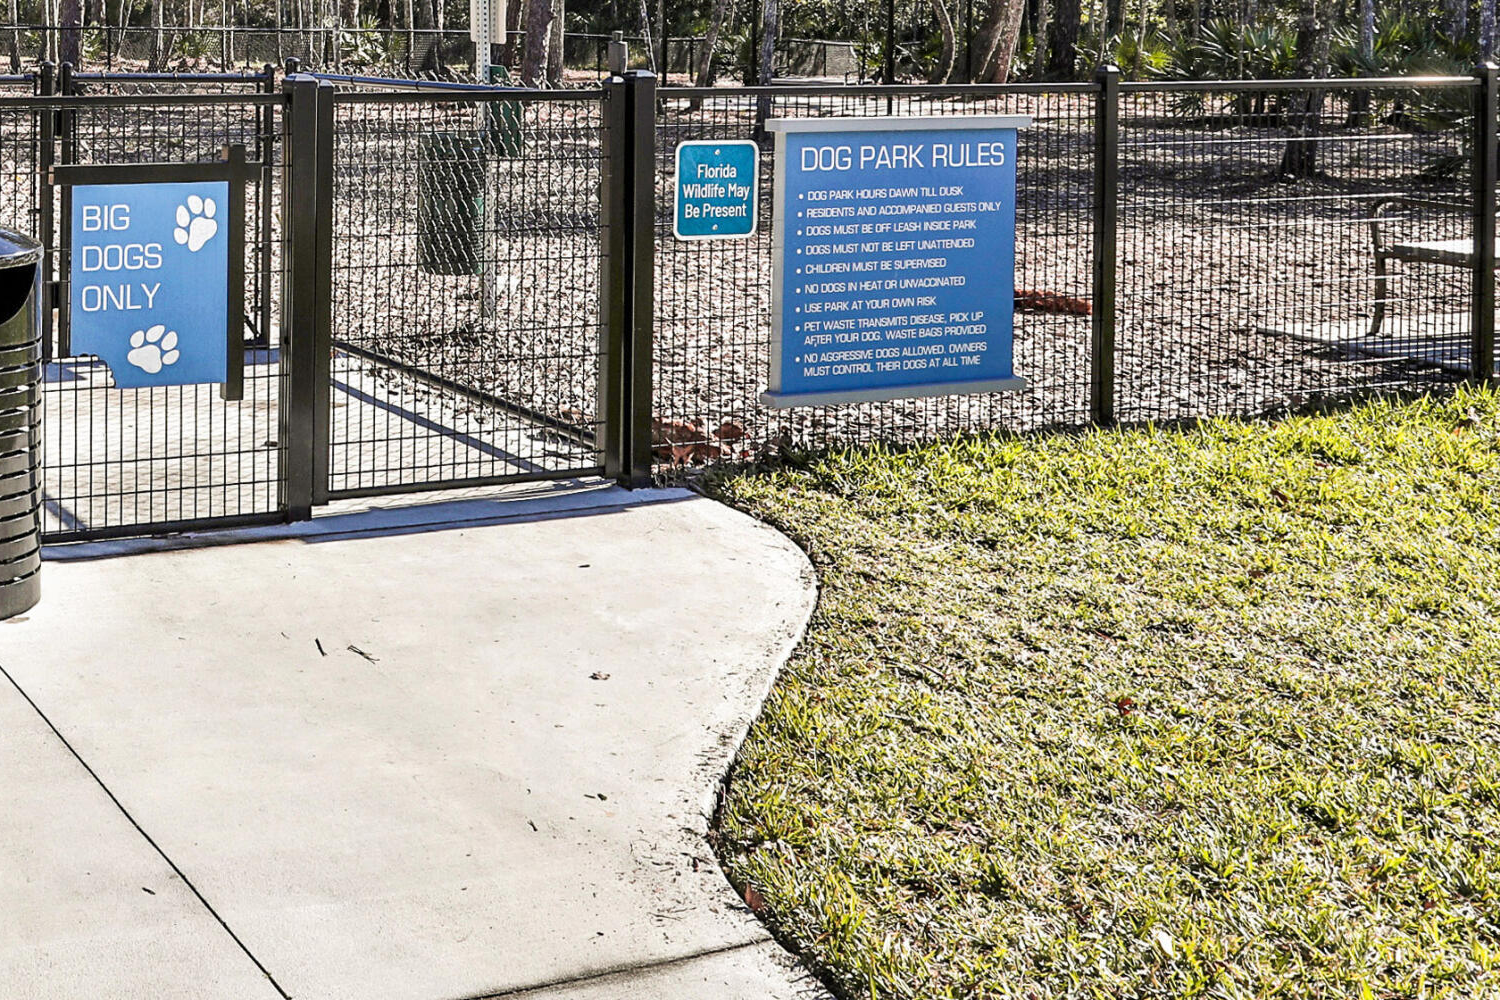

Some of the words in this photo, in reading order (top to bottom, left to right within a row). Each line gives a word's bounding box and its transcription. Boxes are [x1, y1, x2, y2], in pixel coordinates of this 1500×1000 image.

[802, 147, 852, 171] DOG
[861, 145, 924, 169] PARK
[933, 143, 1004, 167] RULES
[697, 164, 737, 179] Florida
[683, 184, 725, 198] Wildlife
[728, 184, 750, 201] May
[808, 191, 827, 200] DOG
[829, 190, 854, 199] PARK
[856, 189, 886, 199] HOURS
[889, 188, 918, 198] DAWN
[920, 187, 937, 196] TILL
[940, 186, 963, 196] DUSK
[82, 204, 130, 232] BIG
[685, 204, 700, 218] Be
[703, 203, 746, 218] Present
[807, 208, 854, 218] RESIDENTS
[857, 206, 876, 216] AND
[880, 204, 942, 215] ACCOMPANIED
[944, 203, 977, 212] GUESTS
[979, 202, 1001, 211] ONLY
[806, 226, 831, 236] DOGS
[834, 224, 859, 234] MUST
[862, 224, 873, 233] BE
[876, 223, 891, 233] OFF
[893, 222, 921, 232] LEASH
[924, 221, 950, 231] INSIDE
[953, 220, 976, 229] PARK
[806, 245, 830, 255] DOGS
[833, 244, 859, 253] MUST
[861, 243, 879, 252] NOT
[882, 242, 893, 251] BE
[896, 241, 915, 250] LEFT
[918, 238, 974, 249] UNATTENDED
[82, 243, 163, 272] DOGS
[806, 264, 850, 274] CHILDREN
[852, 262, 878, 272] MUST
[881, 261, 892, 270] BE
[895, 257, 946, 269] SUPERVISED
[805, 284, 818, 294] NO
[821, 283, 845, 293] DOGS
[848, 282, 857, 291] IN
[860, 280, 882, 290] HEAT
[885, 280, 897, 289] OR
[900, 277, 965, 288] UNVACCINATED
[82, 283, 161, 312] ONLY
[805, 304, 822, 313] USE
[825, 302, 849, 312] PARK
[851, 301, 862, 310] AT
[866, 299, 890, 309] YOUR
[892, 298, 914, 307] OWN
[917, 296, 936, 306] RISK
[804, 322, 820, 331] PET
[823, 320, 855, 330] WASTE
[858, 316, 907, 328] TRANSMITS
[950, 313, 969, 323] PICK
[972, 312, 983, 321] UP
[804, 334, 831, 345] AFTER
[835, 333, 859, 343] YOUR
[862, 331, 882, 341] DOG.
[886, 328, 916, 340] WASTE
[919, 327, 942, 337] BAGS
[945, 324, 986, 336] PROVIDED
[804, 353, 818, 363] NO
[820, 350, 873, 362] AGGRESSIVE
[876, 348, 899, 358] DOGS
[902, 345, 946, 356] ALLOWED.
[949, 342, 987, 353] OWNERS
[804, 366, 830, 377] MUST
[832, 364, 873, 375] CONTROL
[876, 361, 900, 371] THEIR
[903, 359, 927, 369] DOGS
[929, 358, 940, 367] AT
[942, 357, 958, 367] ALL
[961, 355, 980, 365] TIME
